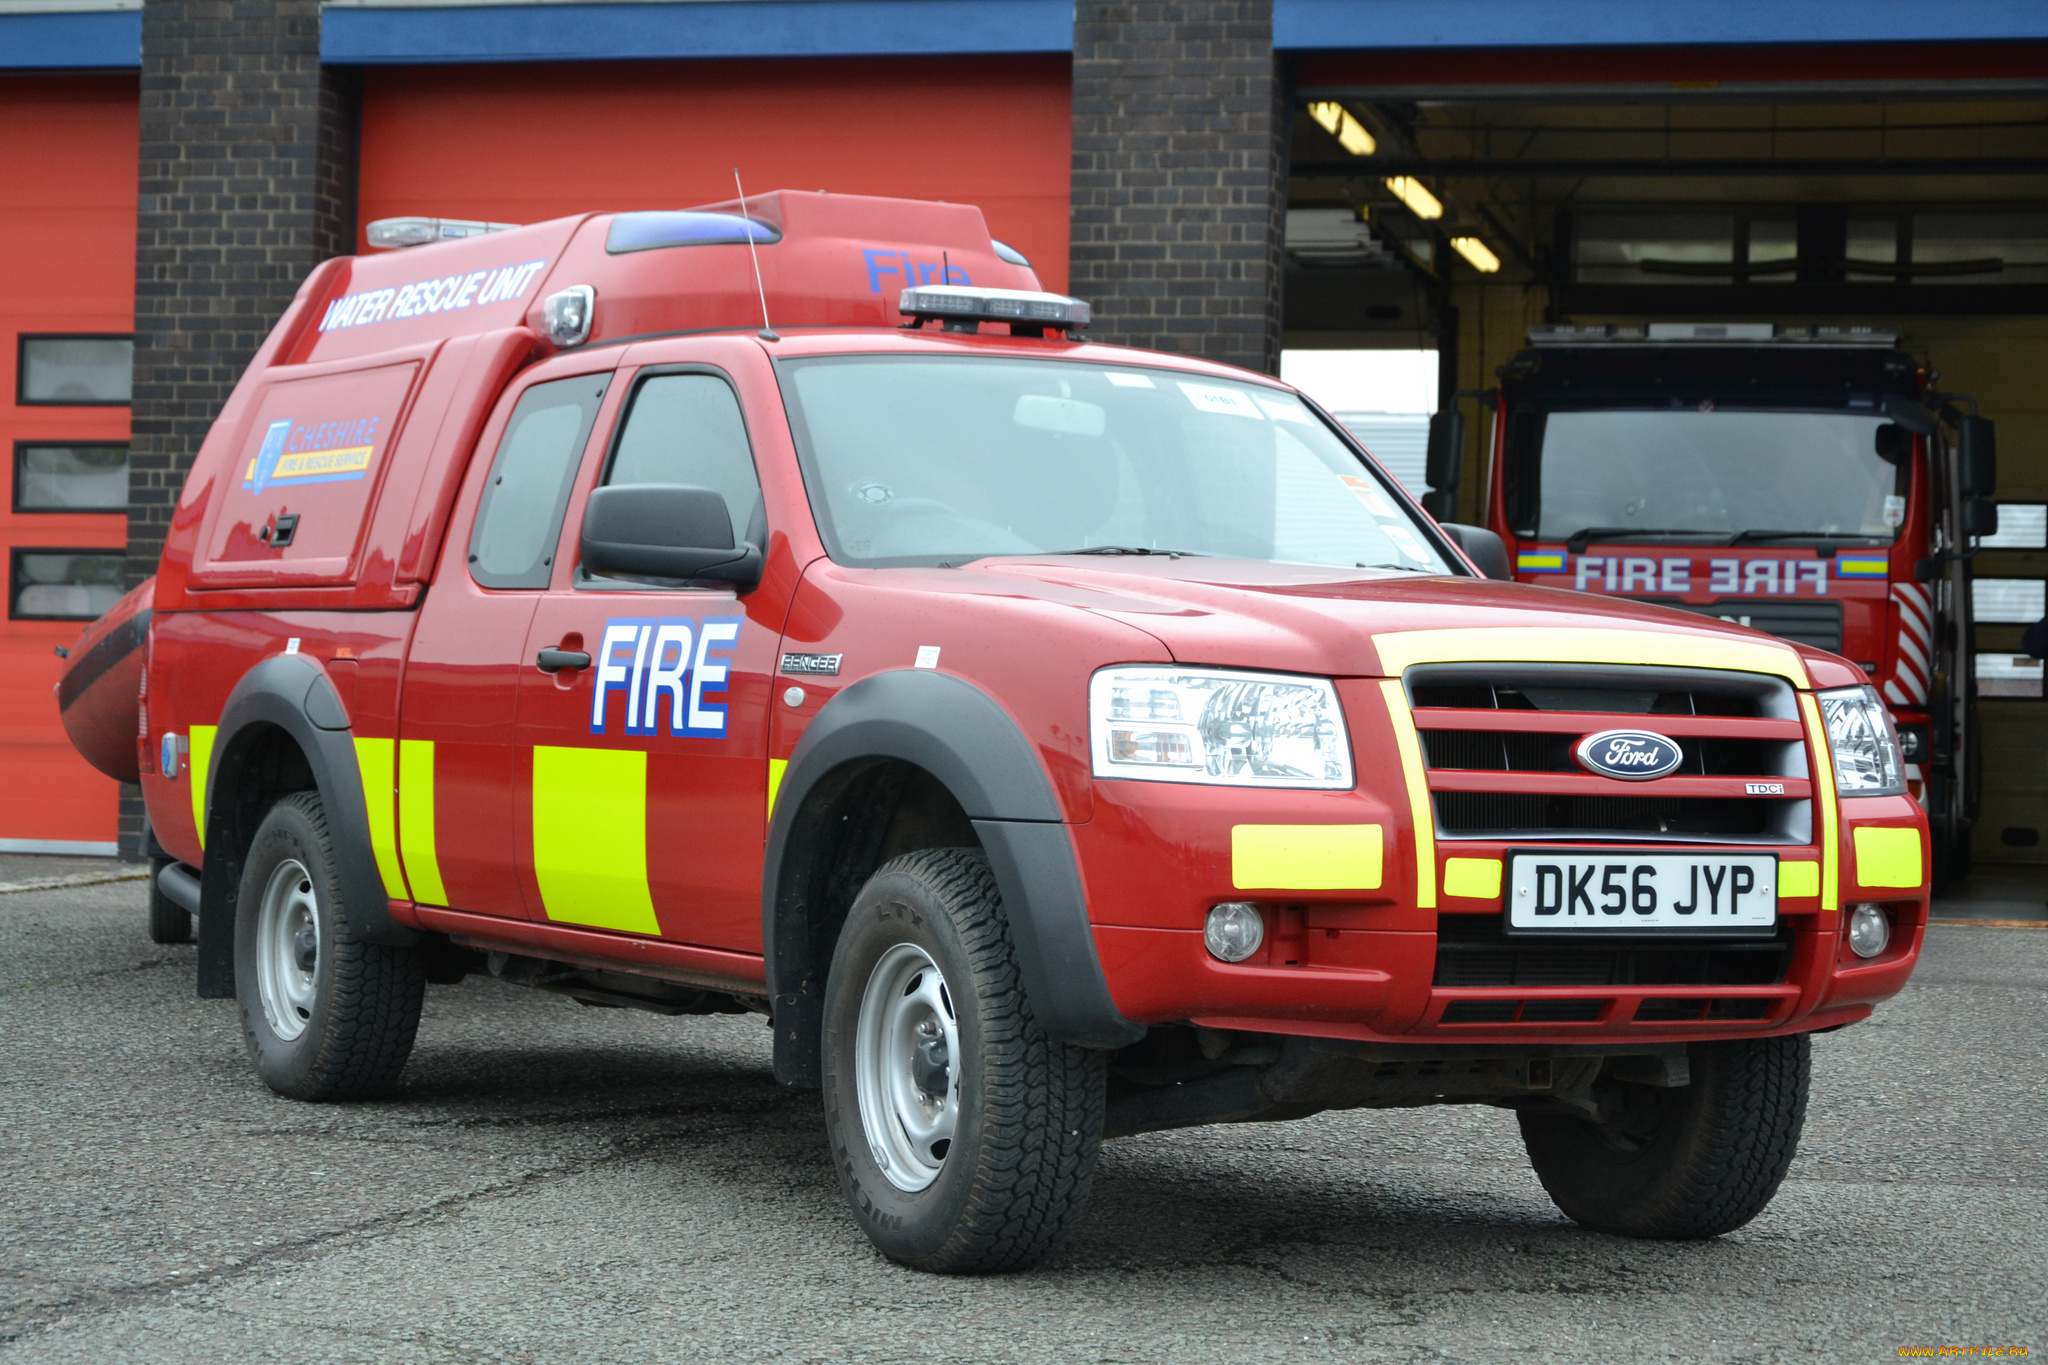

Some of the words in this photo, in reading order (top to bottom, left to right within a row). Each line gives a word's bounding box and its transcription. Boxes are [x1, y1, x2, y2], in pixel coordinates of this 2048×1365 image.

[862, 249, 973, 294] Fire
[317, 286, 397, 333] WATER
[385, 268, 489, 321] RESCUE
[476, 258, 547, 305] UNIT
[289, 416, 380, 452] CHESHIRE
[305, 453, 335, 470] RESCUE
[334, 450, 367, 468] SERVICE
[1575, 556, 1692, 593] FIRE
[590, 616, 744, 738] FIRE
[782, 655, 839, 672] RANGER
[1605, 739, 1659, 766] Ford
[1748, 784, 1783, 793] TDCi
[1534, 865, 1658, 916] DK56
[1673, 865, 1755, 916] JYP
[875, 901, 924, 930] LTX
[825, 1028, 903, 1234] MICHELIN
